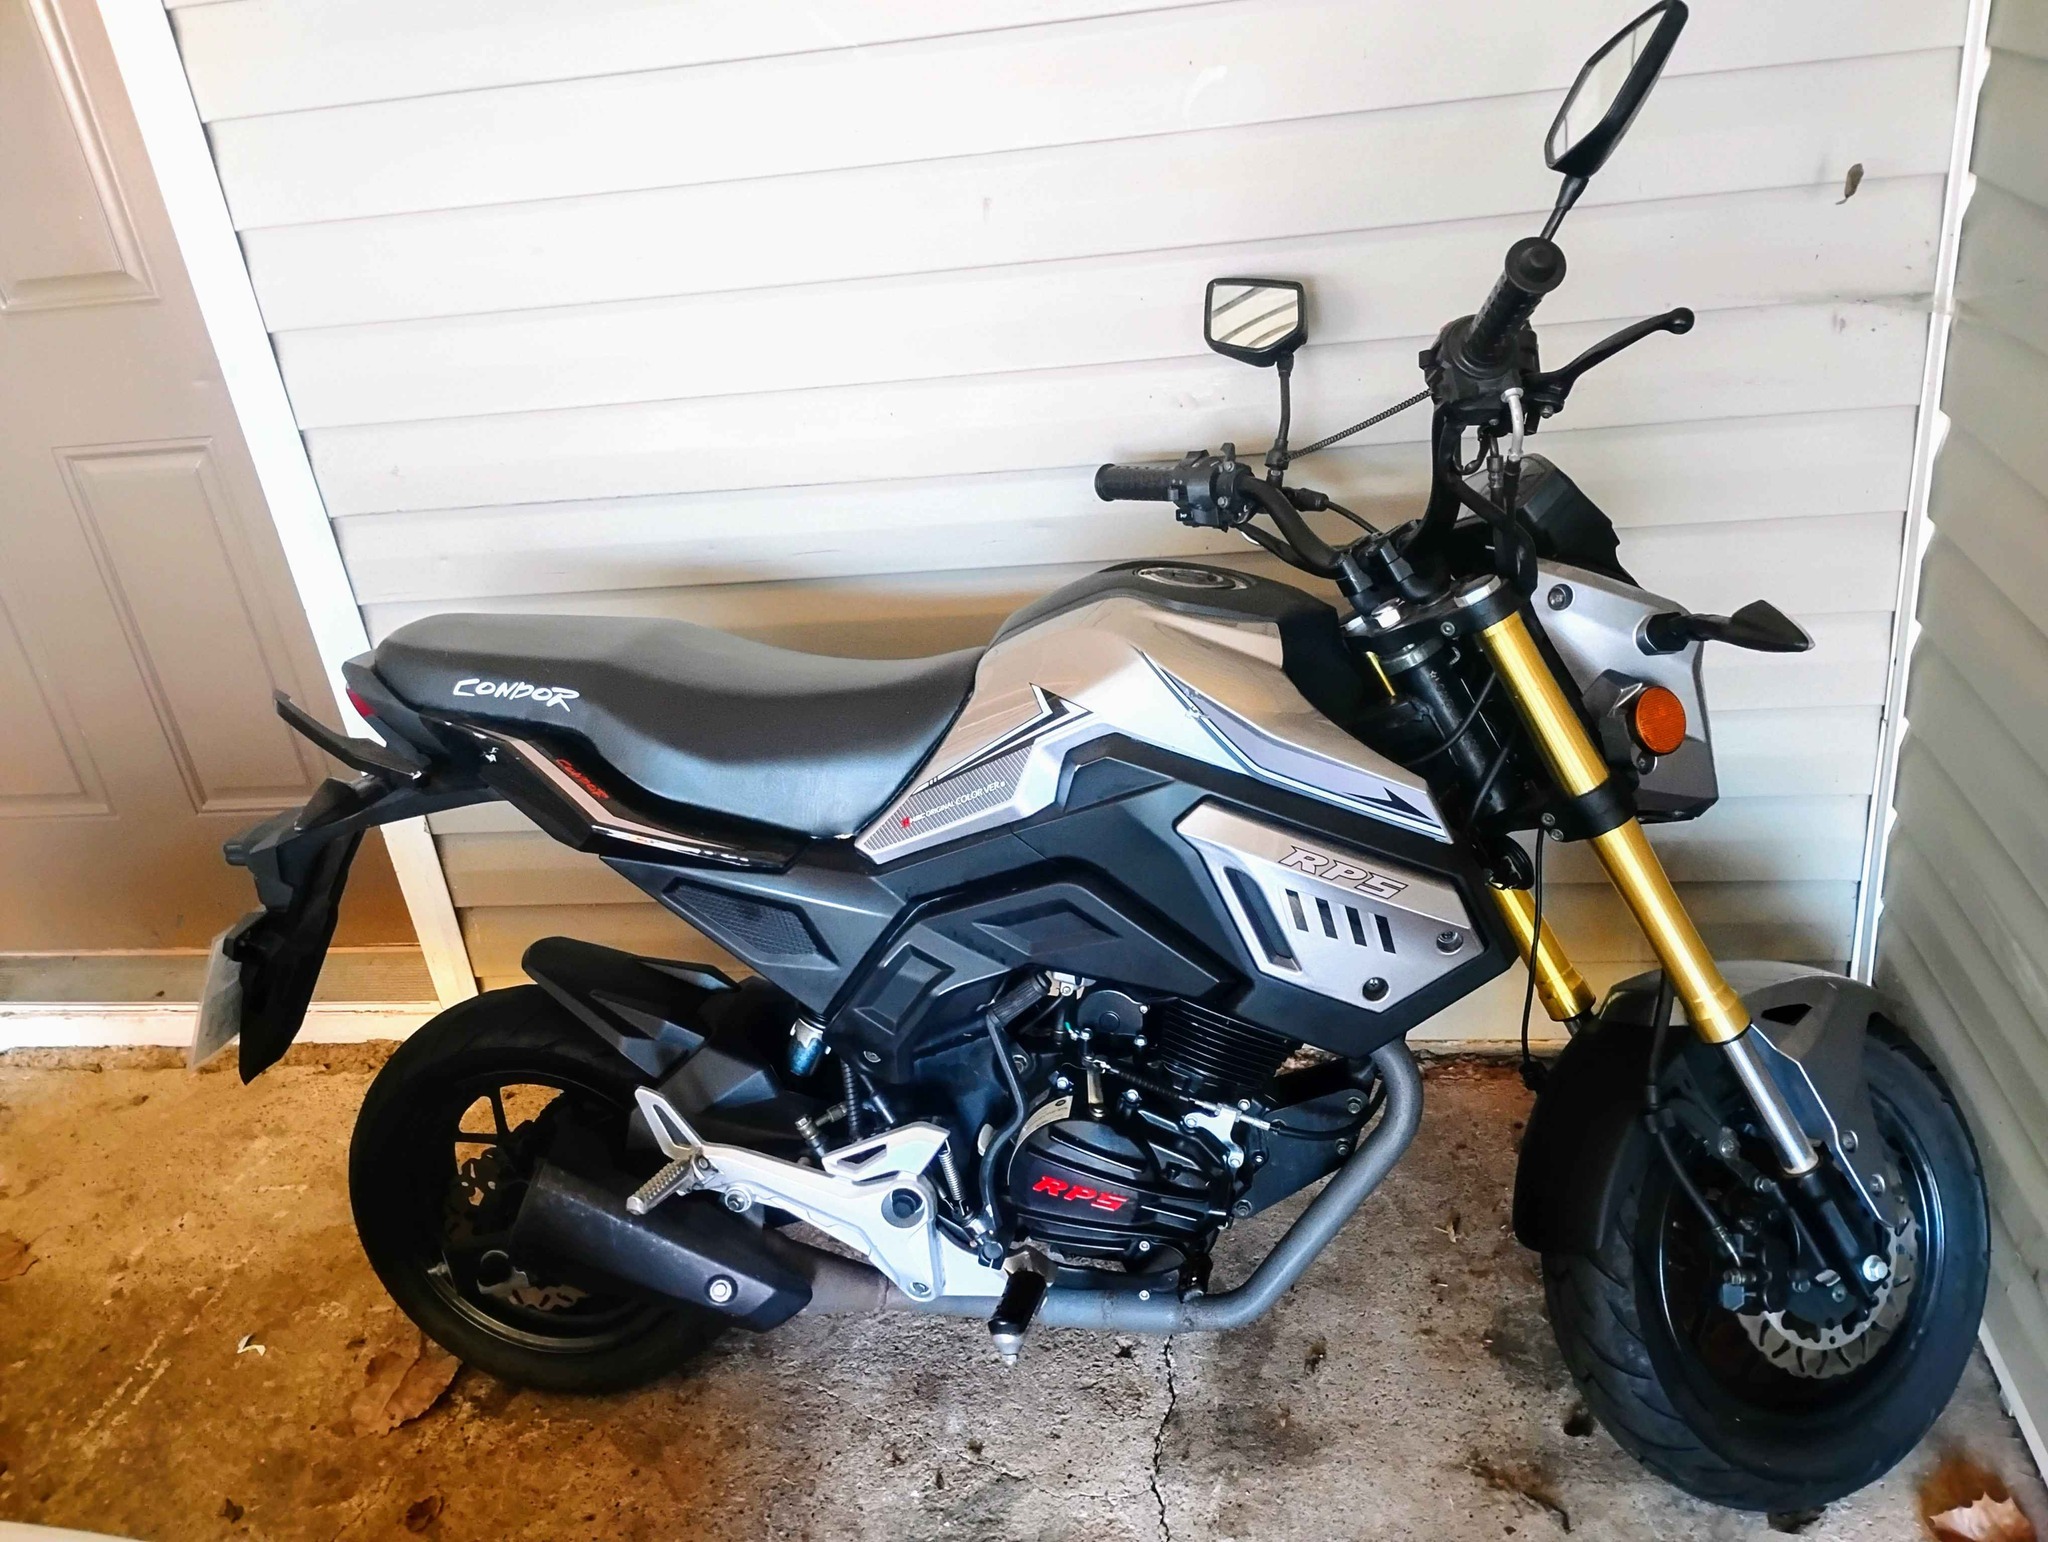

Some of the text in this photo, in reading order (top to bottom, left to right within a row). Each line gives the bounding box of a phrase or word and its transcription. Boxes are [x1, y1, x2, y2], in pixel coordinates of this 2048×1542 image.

[453, 678, 580, 712] CONDOR
[955, 788, 983, 805] COLOR
[1278, 845, 1409, 900] RPS
[1032, 1175, 1129, 1212] RPS
